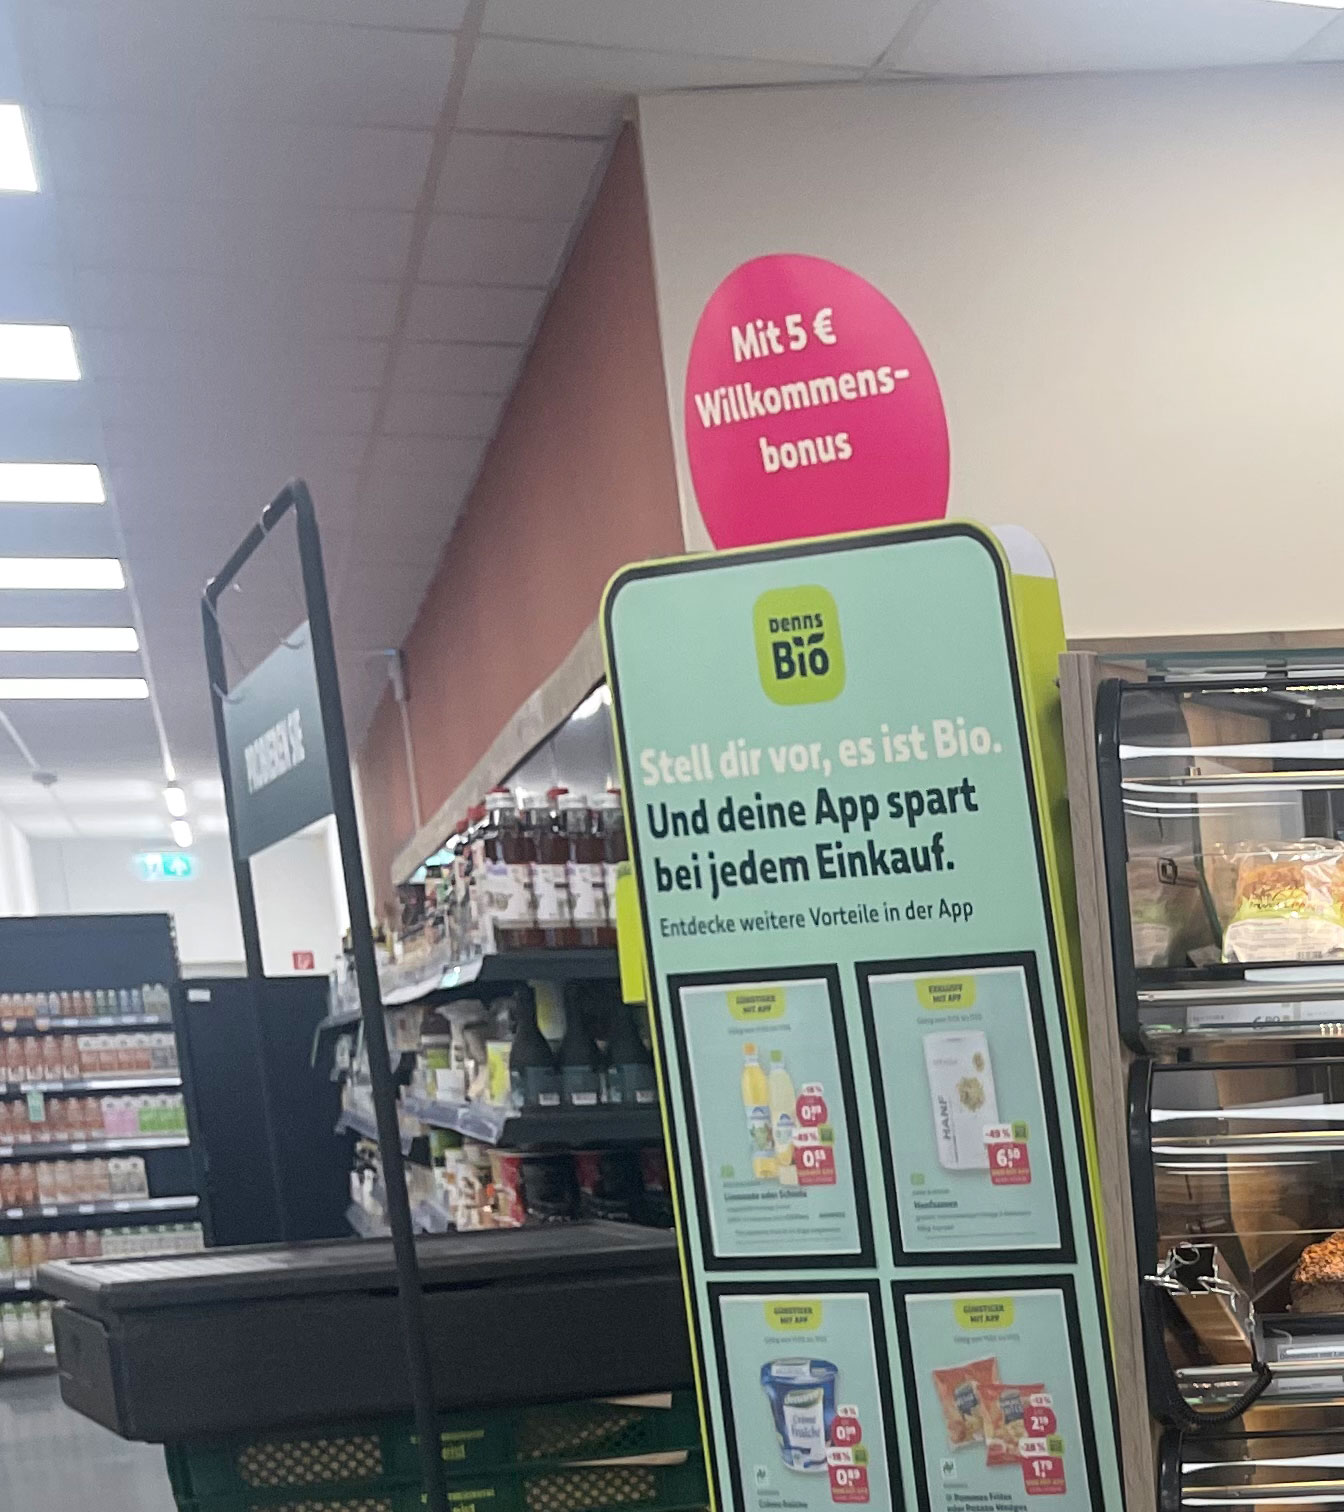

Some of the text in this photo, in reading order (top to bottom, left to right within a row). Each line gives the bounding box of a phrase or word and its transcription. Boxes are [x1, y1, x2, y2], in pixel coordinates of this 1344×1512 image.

[731, 308, 837, 362] Mit 5 €
[696, 364, 910, 428] Willkommens-
[760, 430, 853, 472] bonus
[772, 634, 830, 680] Bio
[640, 719, 1002, 786] Stell dir vor, es ist Bio.
[646, 777, 979, 841] Und deine App spart
[653, 834, 956, 898] bei jedem Einkauf.
[660, 897, 974, 938] Entdecke weitere Vorteile in der App
